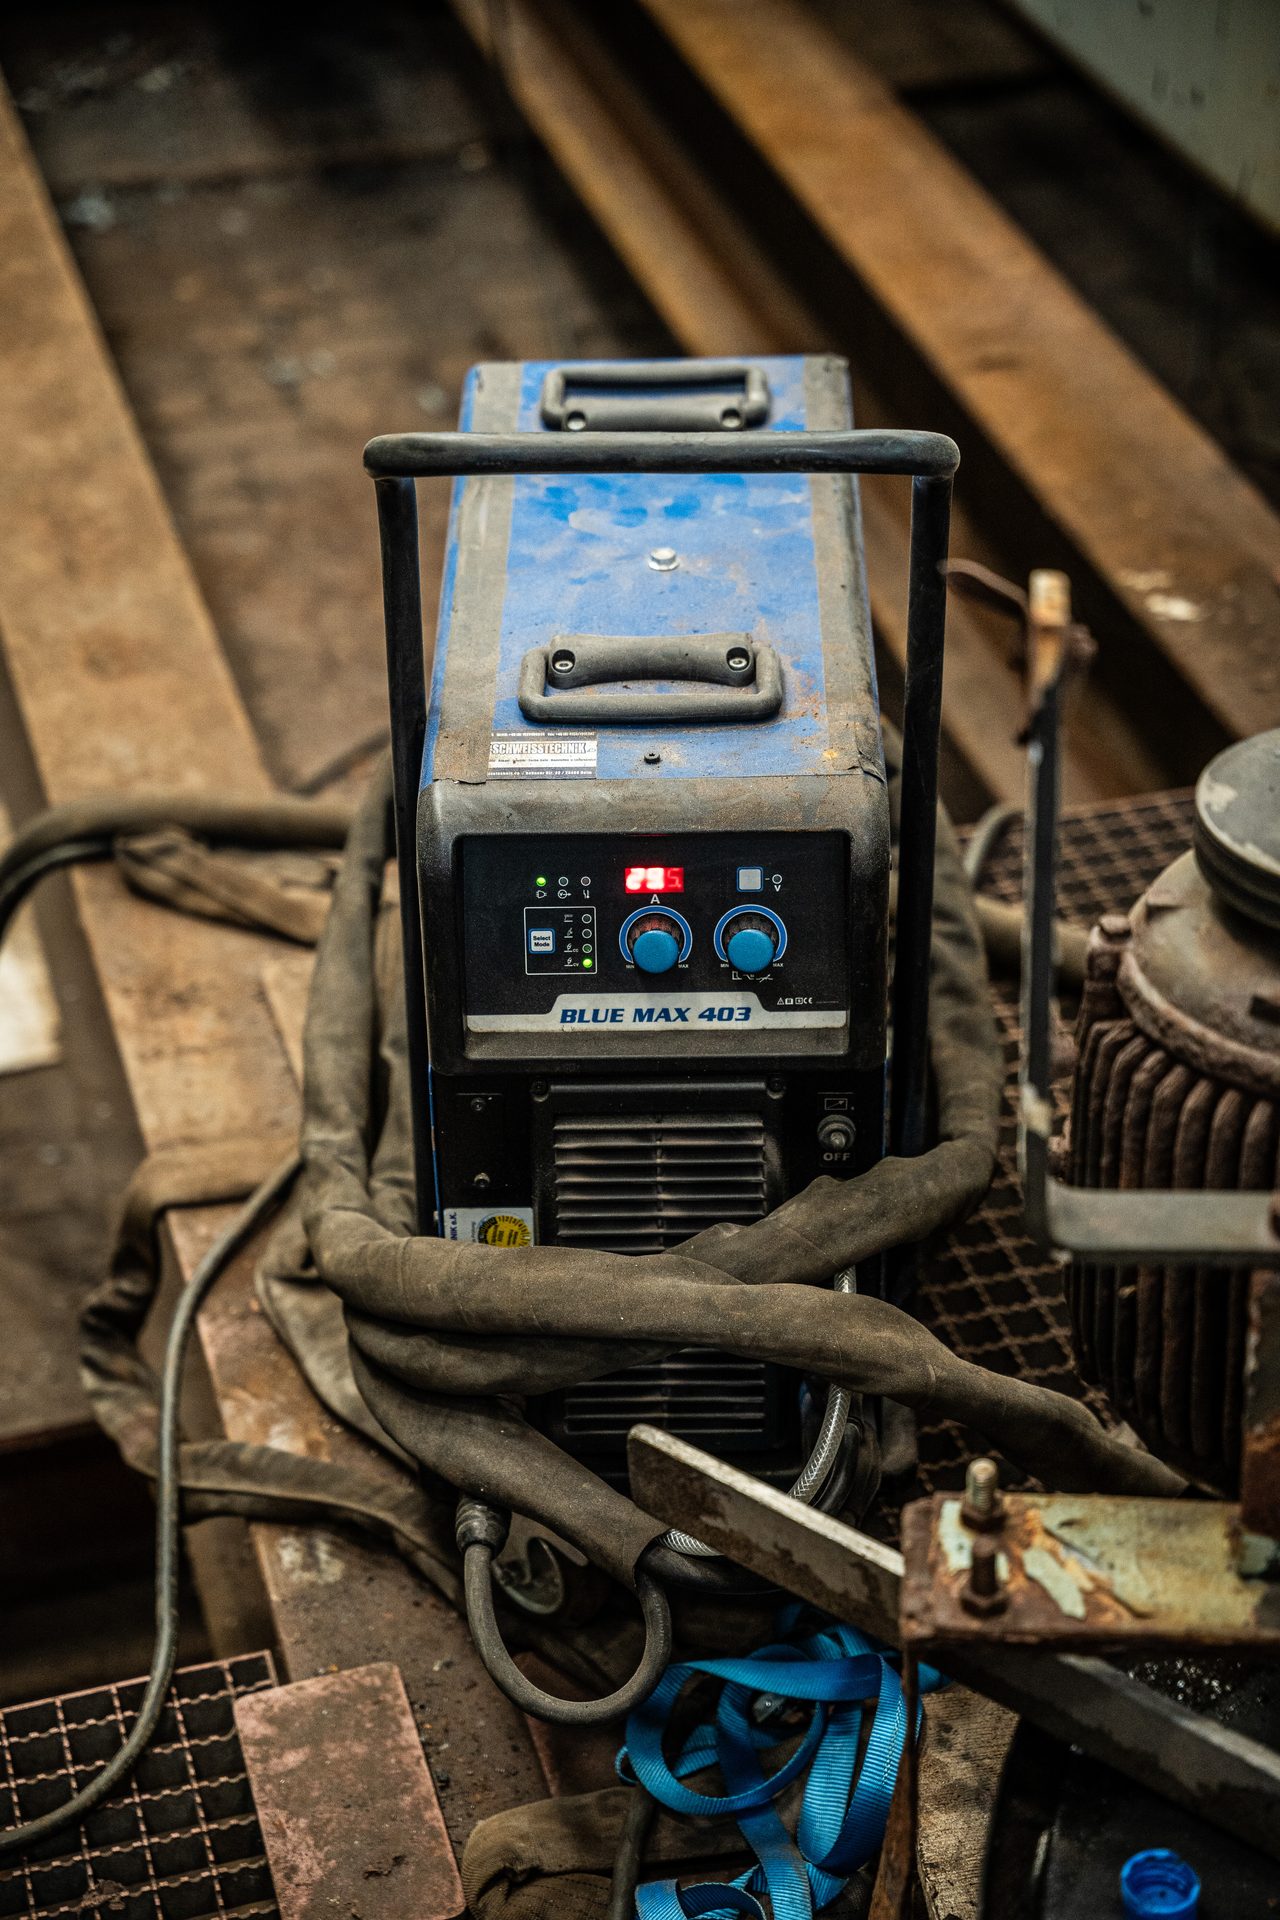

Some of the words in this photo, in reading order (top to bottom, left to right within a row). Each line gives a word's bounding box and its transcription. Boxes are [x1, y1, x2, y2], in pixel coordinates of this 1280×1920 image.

[491, 742, 587, 755] SCHWEISSTECHNIK
[774, 884, 782, 892] V
[650, 893, 660, 904] A
[560, 1008, 625, 1024] BLUE
[632, 1007, 692, 1023] MAX
[697, 1006, 752, 1022] 403
[823, 1152, 851, 1161] OFF
